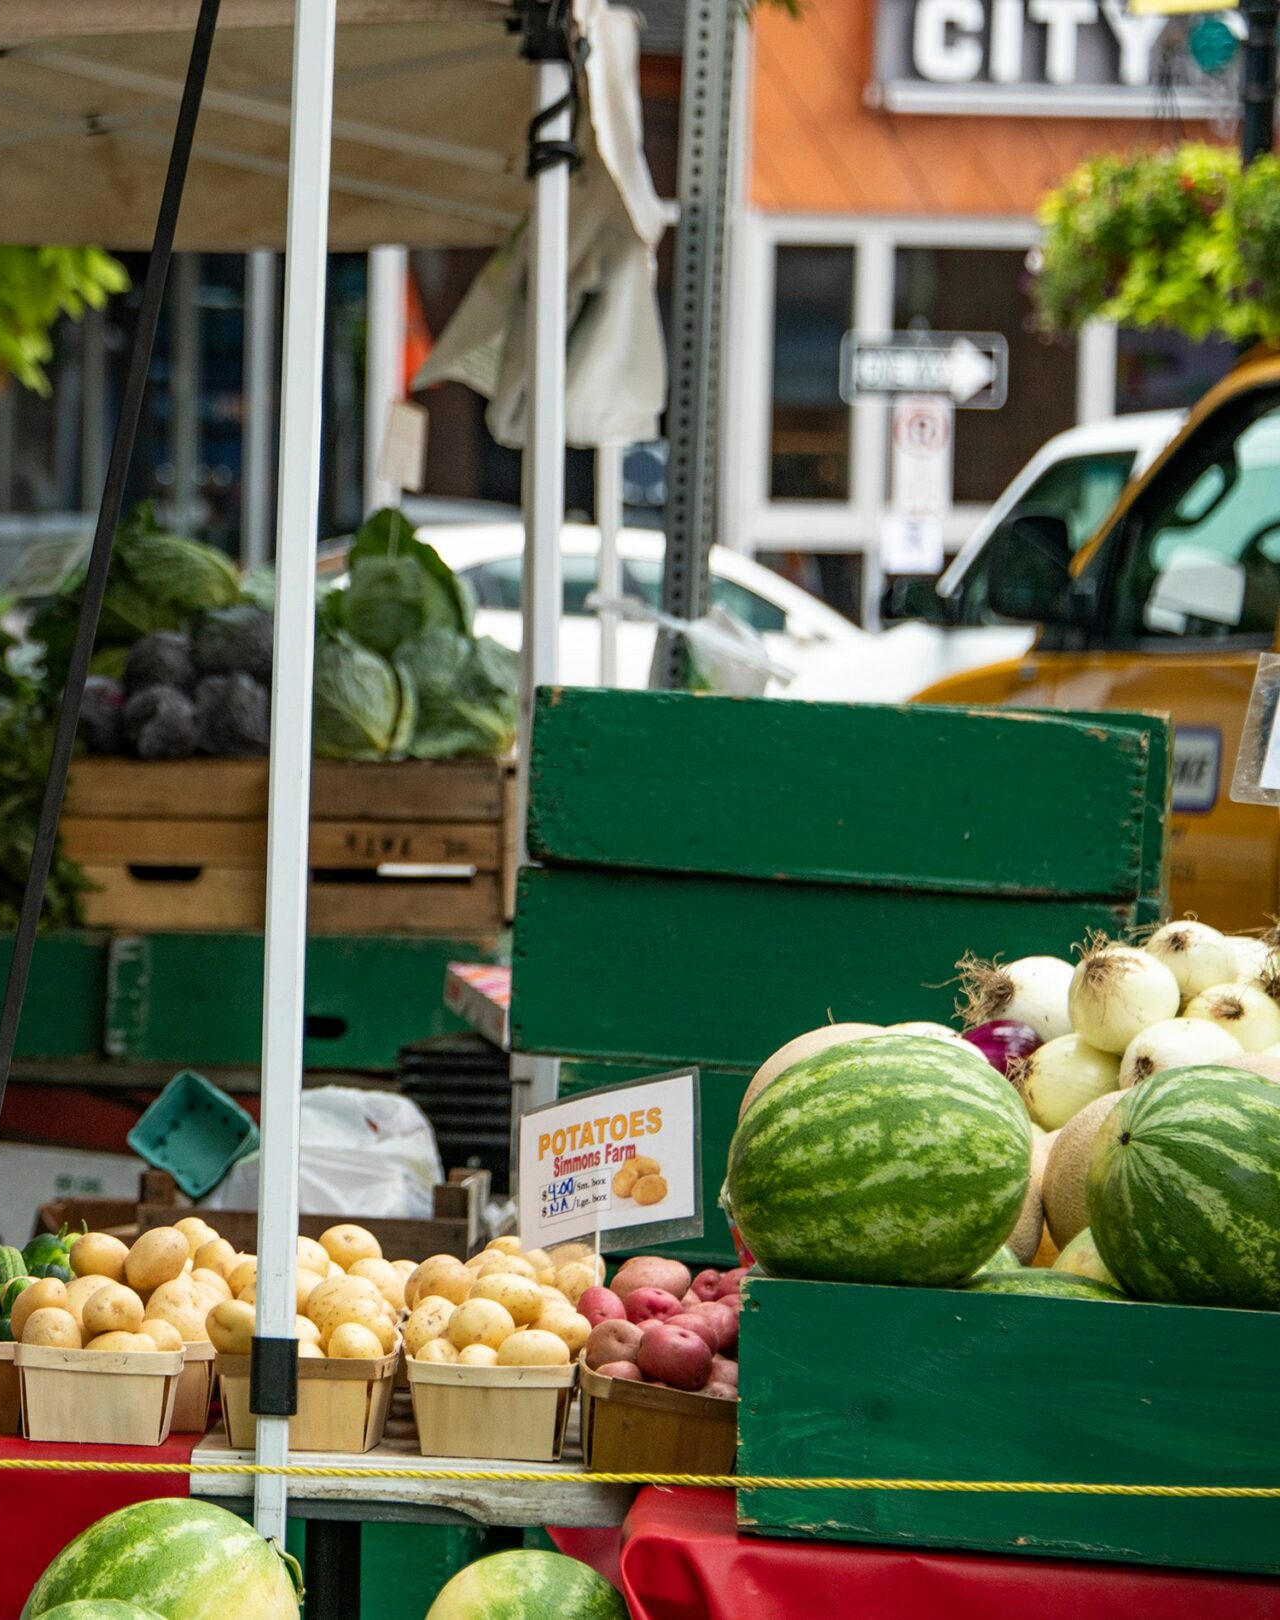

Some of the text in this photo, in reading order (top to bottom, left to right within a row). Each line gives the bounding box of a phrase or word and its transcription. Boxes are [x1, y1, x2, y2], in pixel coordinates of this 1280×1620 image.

[913, 0, 1170, 83] CITY
[538, 1107, 663, 1161] POTATOES
[553, 1143, 636, 1178] Simmons Farm
[591, 1177, 606, 1188] box
[592, 1193, 607, 1203] box
